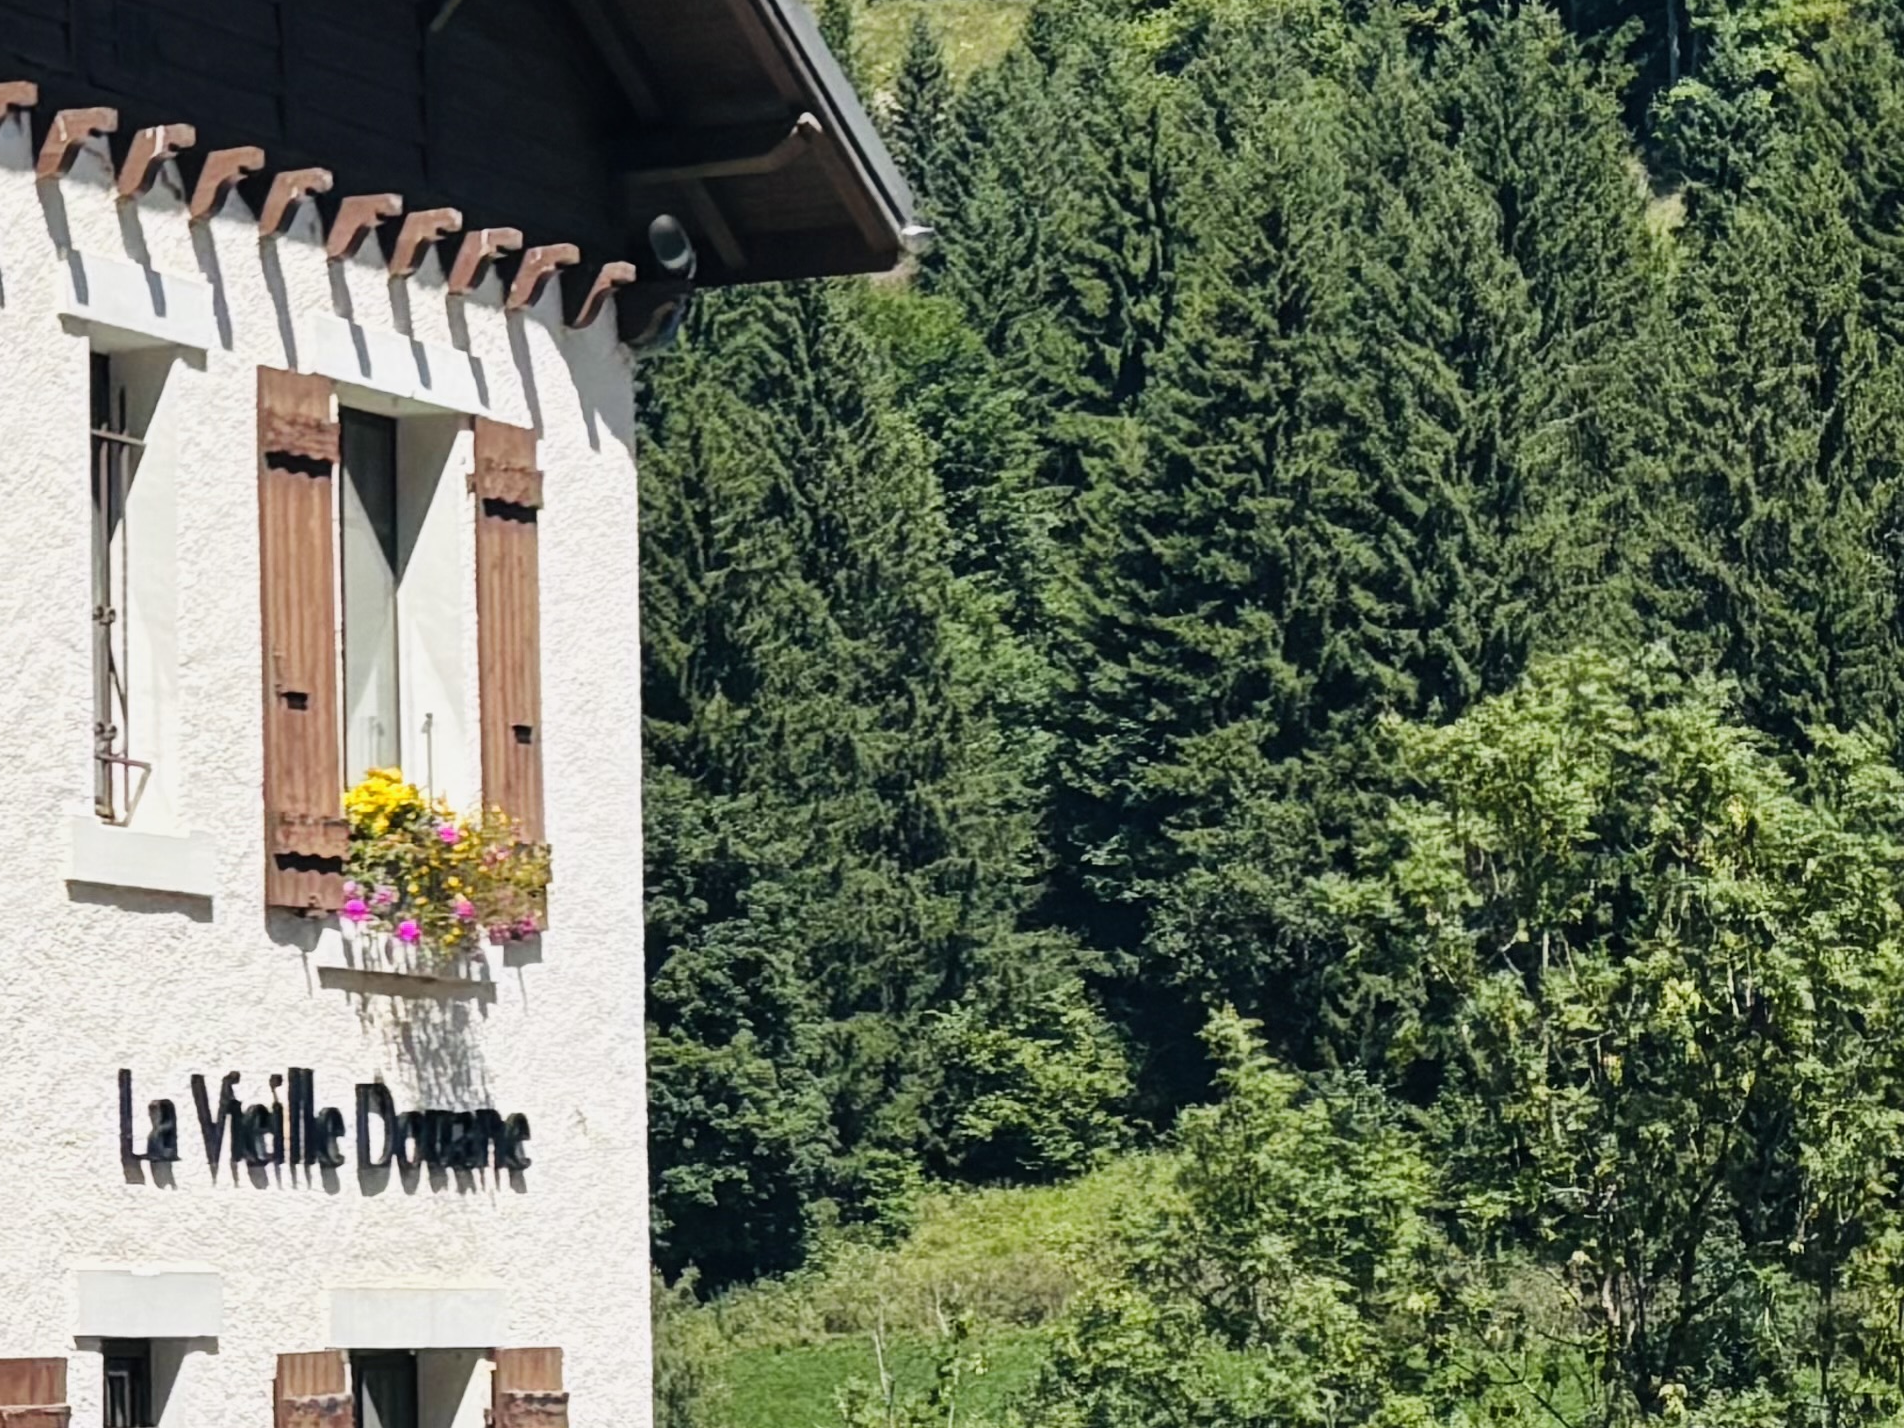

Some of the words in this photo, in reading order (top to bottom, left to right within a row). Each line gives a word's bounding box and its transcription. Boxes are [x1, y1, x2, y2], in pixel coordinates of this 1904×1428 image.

[118, 1068, 180, 1161] La
[191, 1067, 345, 1169] Vieille
[355, 1082, 530, 1170] Douane
